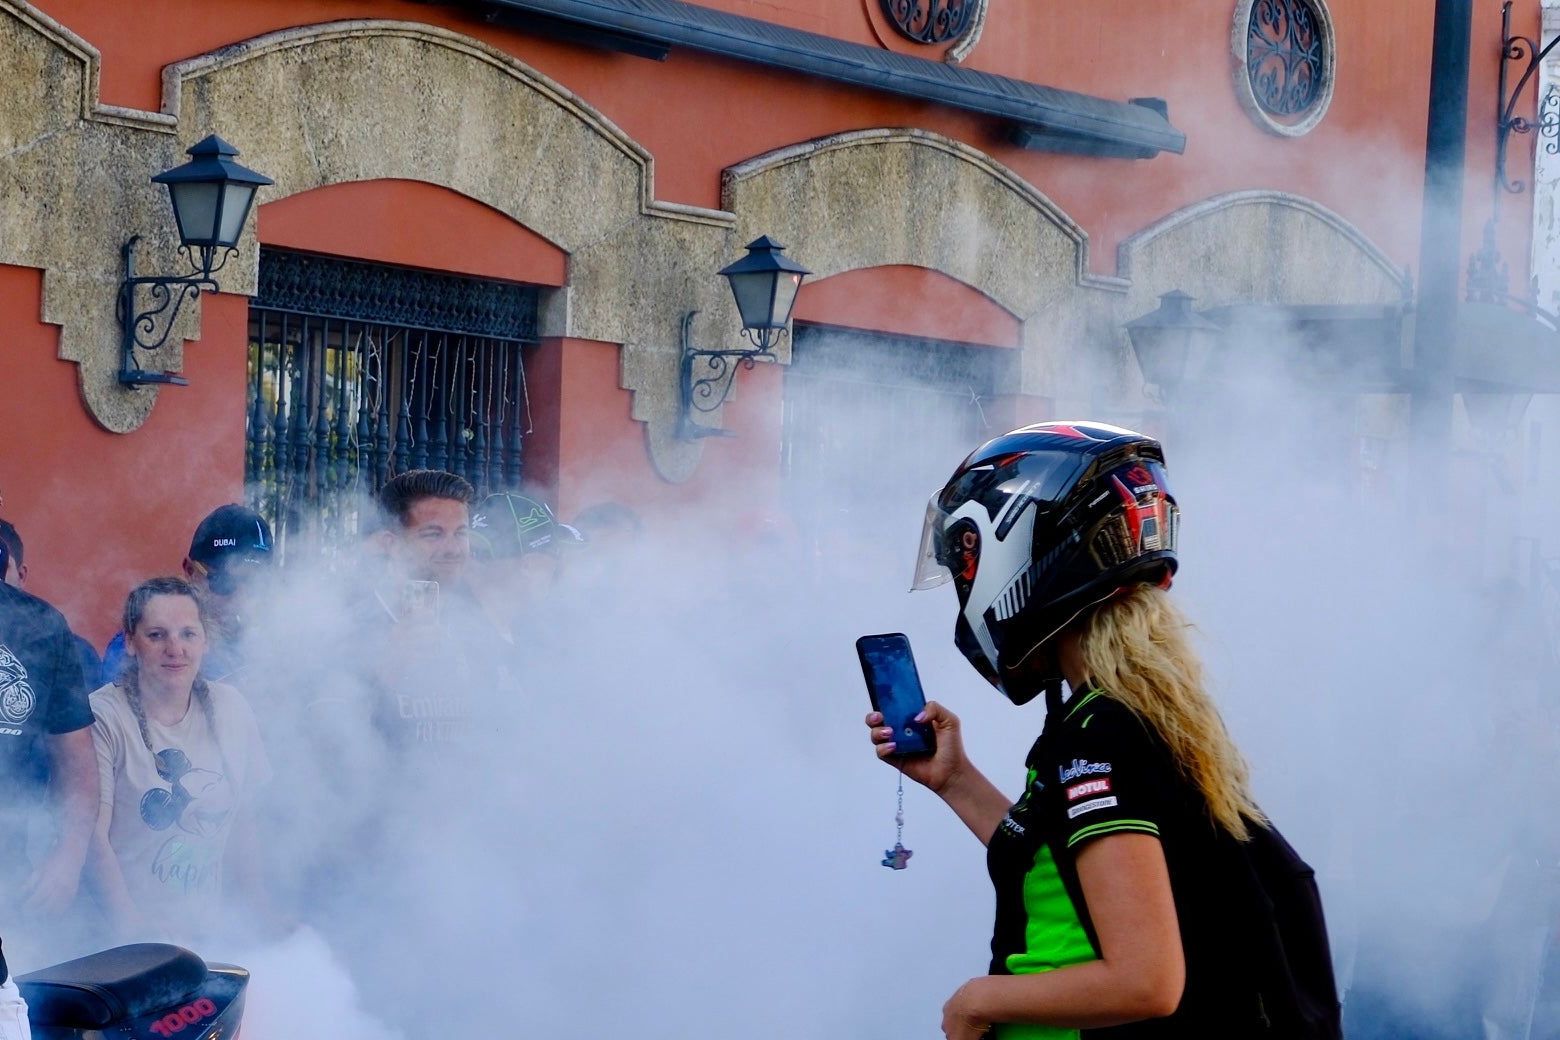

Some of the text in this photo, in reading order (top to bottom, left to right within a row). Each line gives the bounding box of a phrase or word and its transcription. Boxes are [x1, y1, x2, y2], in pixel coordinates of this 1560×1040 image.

[213, 538, 236, 547] DUBAI
[1059, 758, 1113, 784] LeoVince
[1069, 780, 1109, 800] MOTUL
[149, 997, 217, 1037] 1000
